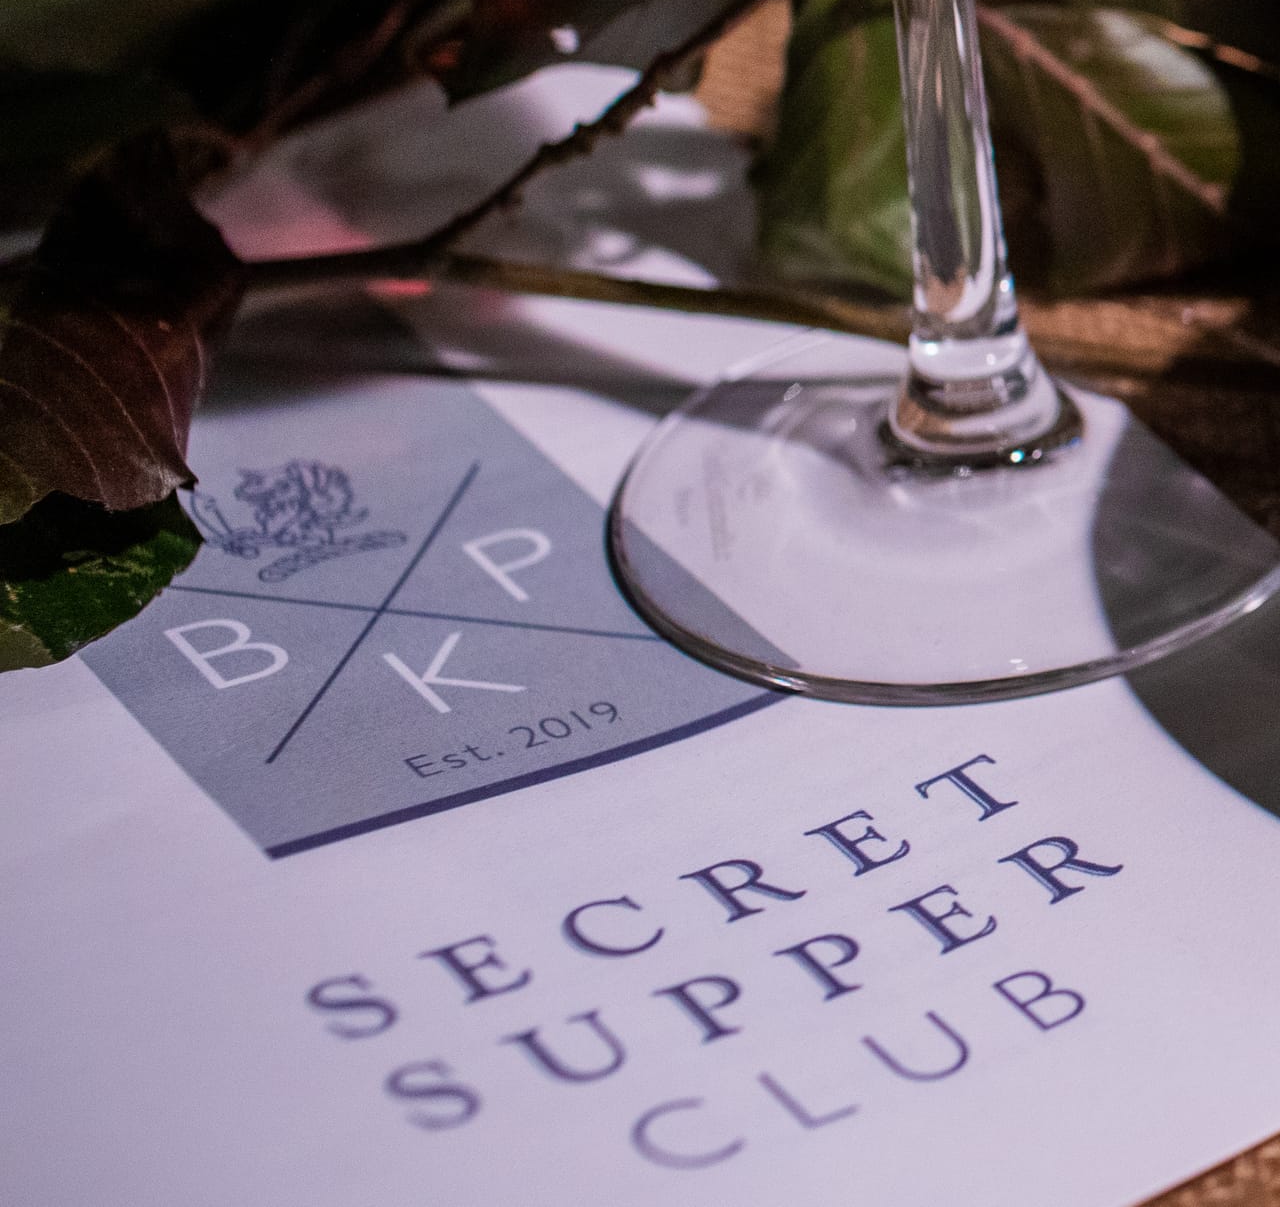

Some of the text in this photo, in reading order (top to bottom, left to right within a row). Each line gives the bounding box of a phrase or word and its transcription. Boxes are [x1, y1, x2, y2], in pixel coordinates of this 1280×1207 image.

[463, 527, 552, 602] P
[164, 620, 290, 690] B
[382, 632, 529, 714] K
[404, 700, 620, 780] Est. 2019
[304, 754, 1019, 1041] SECRET
[384, 836, 1124, 1131] SUPPER
[630, 970, 1087, 1170] CLUB
